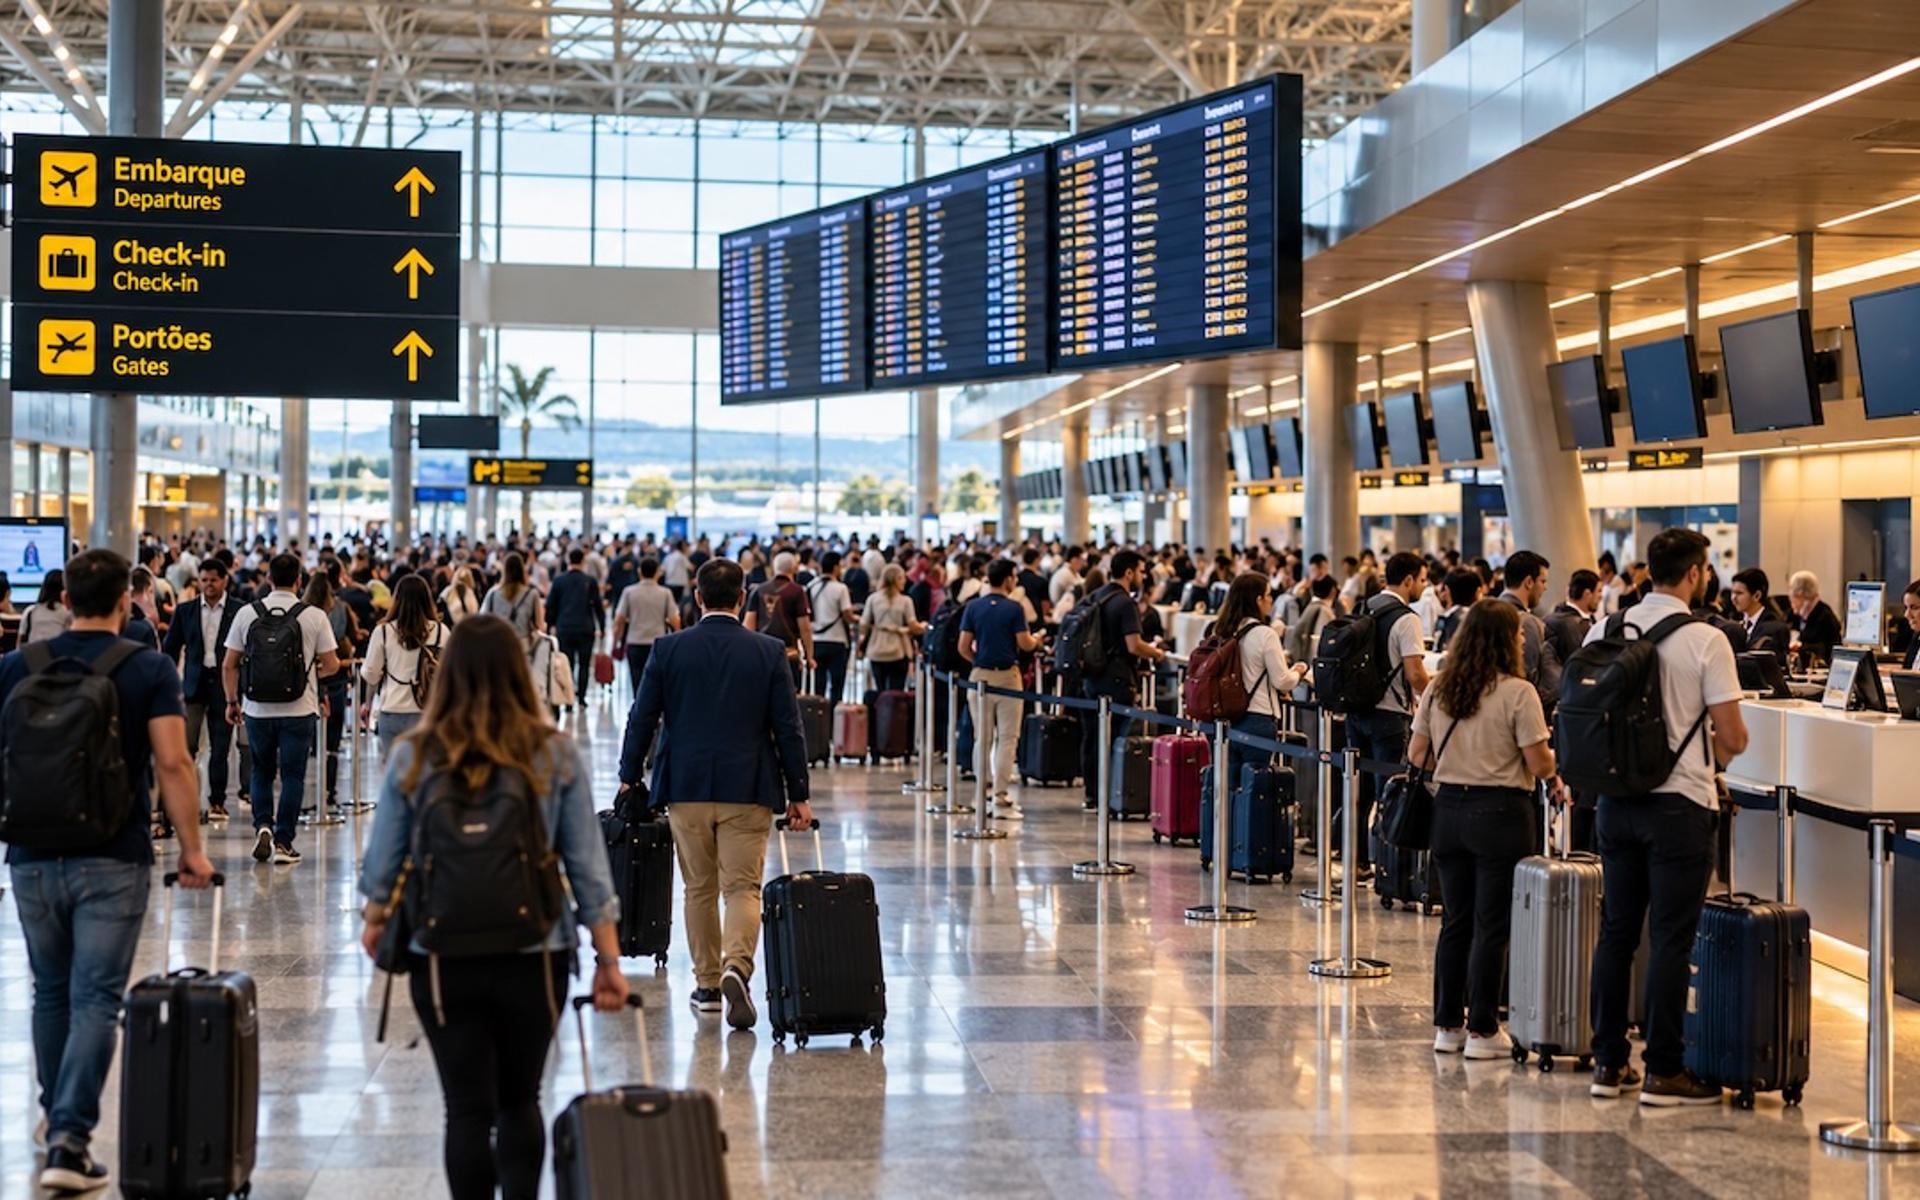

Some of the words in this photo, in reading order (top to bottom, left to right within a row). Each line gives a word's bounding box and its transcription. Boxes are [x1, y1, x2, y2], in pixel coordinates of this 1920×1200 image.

[114, 156, 246, 188] Embarque
[114, 187, 222, 211] Departures
[113, 240, 226, 267] Check-in
[112, 270, 199, 292] Check-in
[113, 323, 212, 351] Portões
[112, 355, 169, 376] Gates
